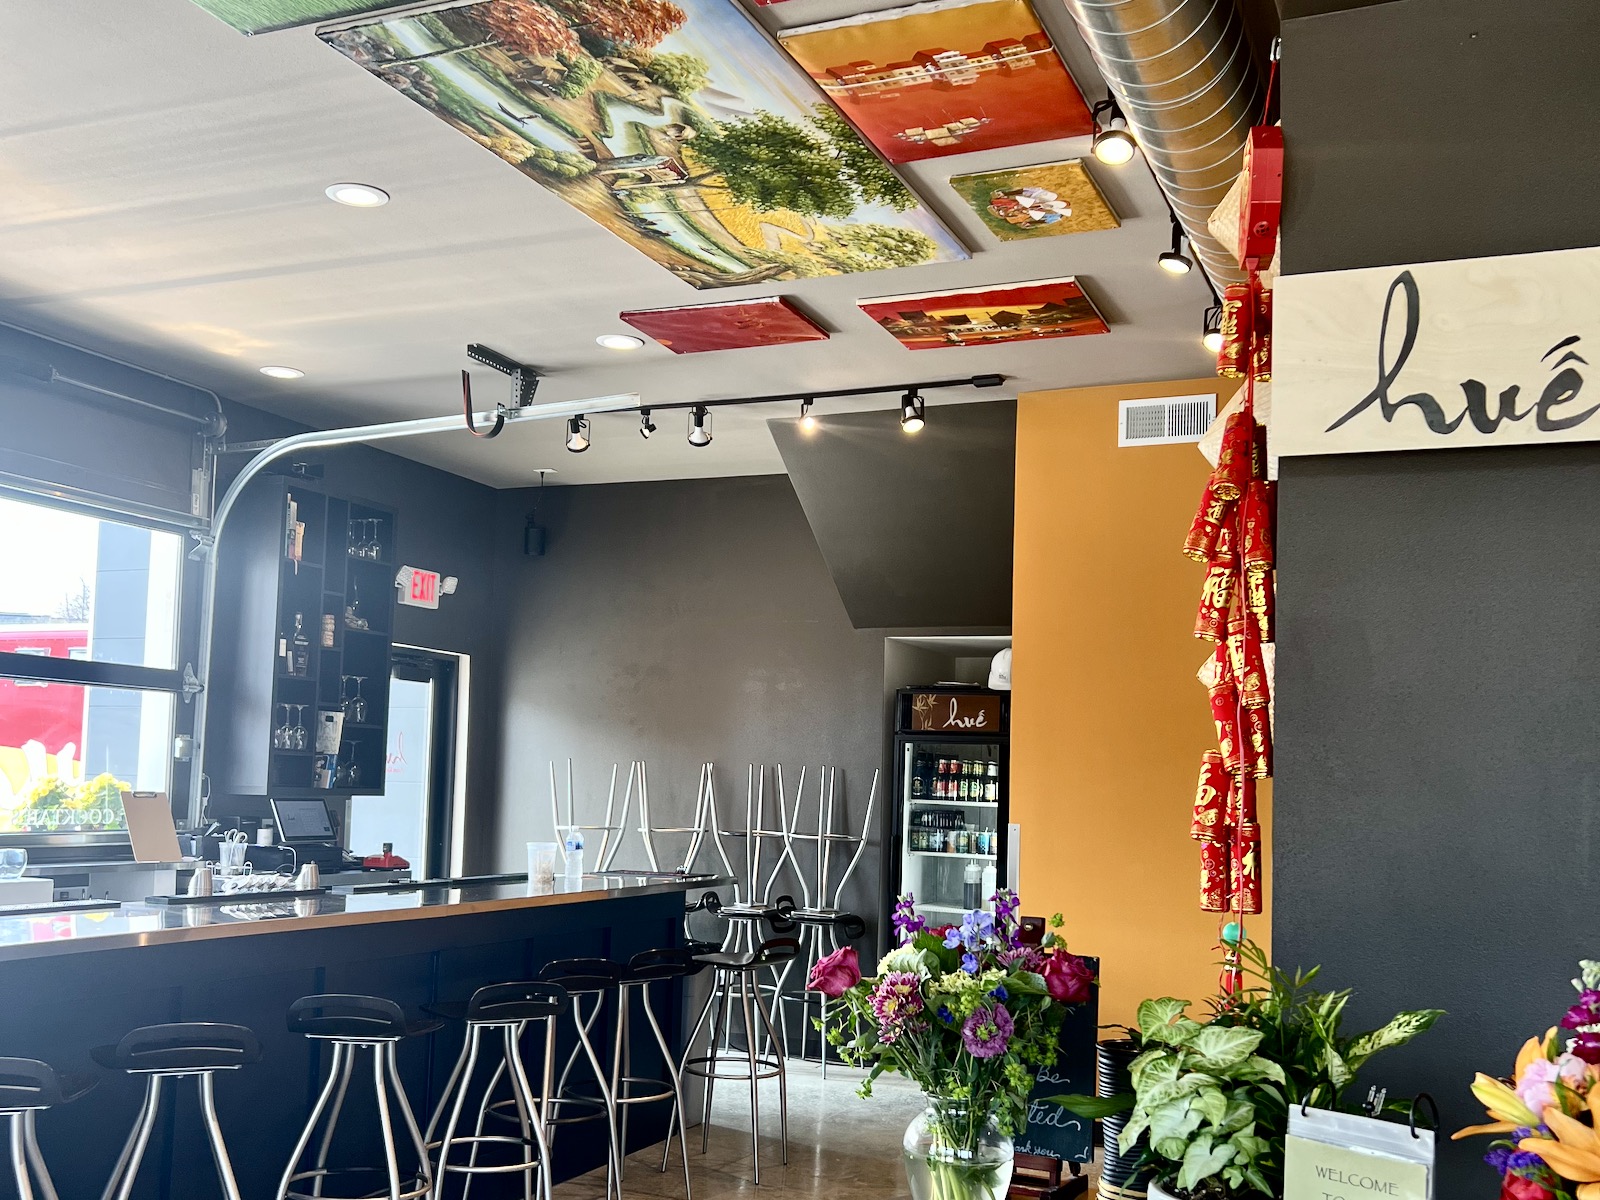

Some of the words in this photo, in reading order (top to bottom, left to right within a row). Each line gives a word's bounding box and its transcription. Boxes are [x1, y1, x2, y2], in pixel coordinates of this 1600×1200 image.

[411, 570, 436, 603] EXIT
[1036, 1066, 1070, 1083] Be
[1033, 1146, 1061, 1159] you
[1315, 1165, 1399, 1196] WELCOME
